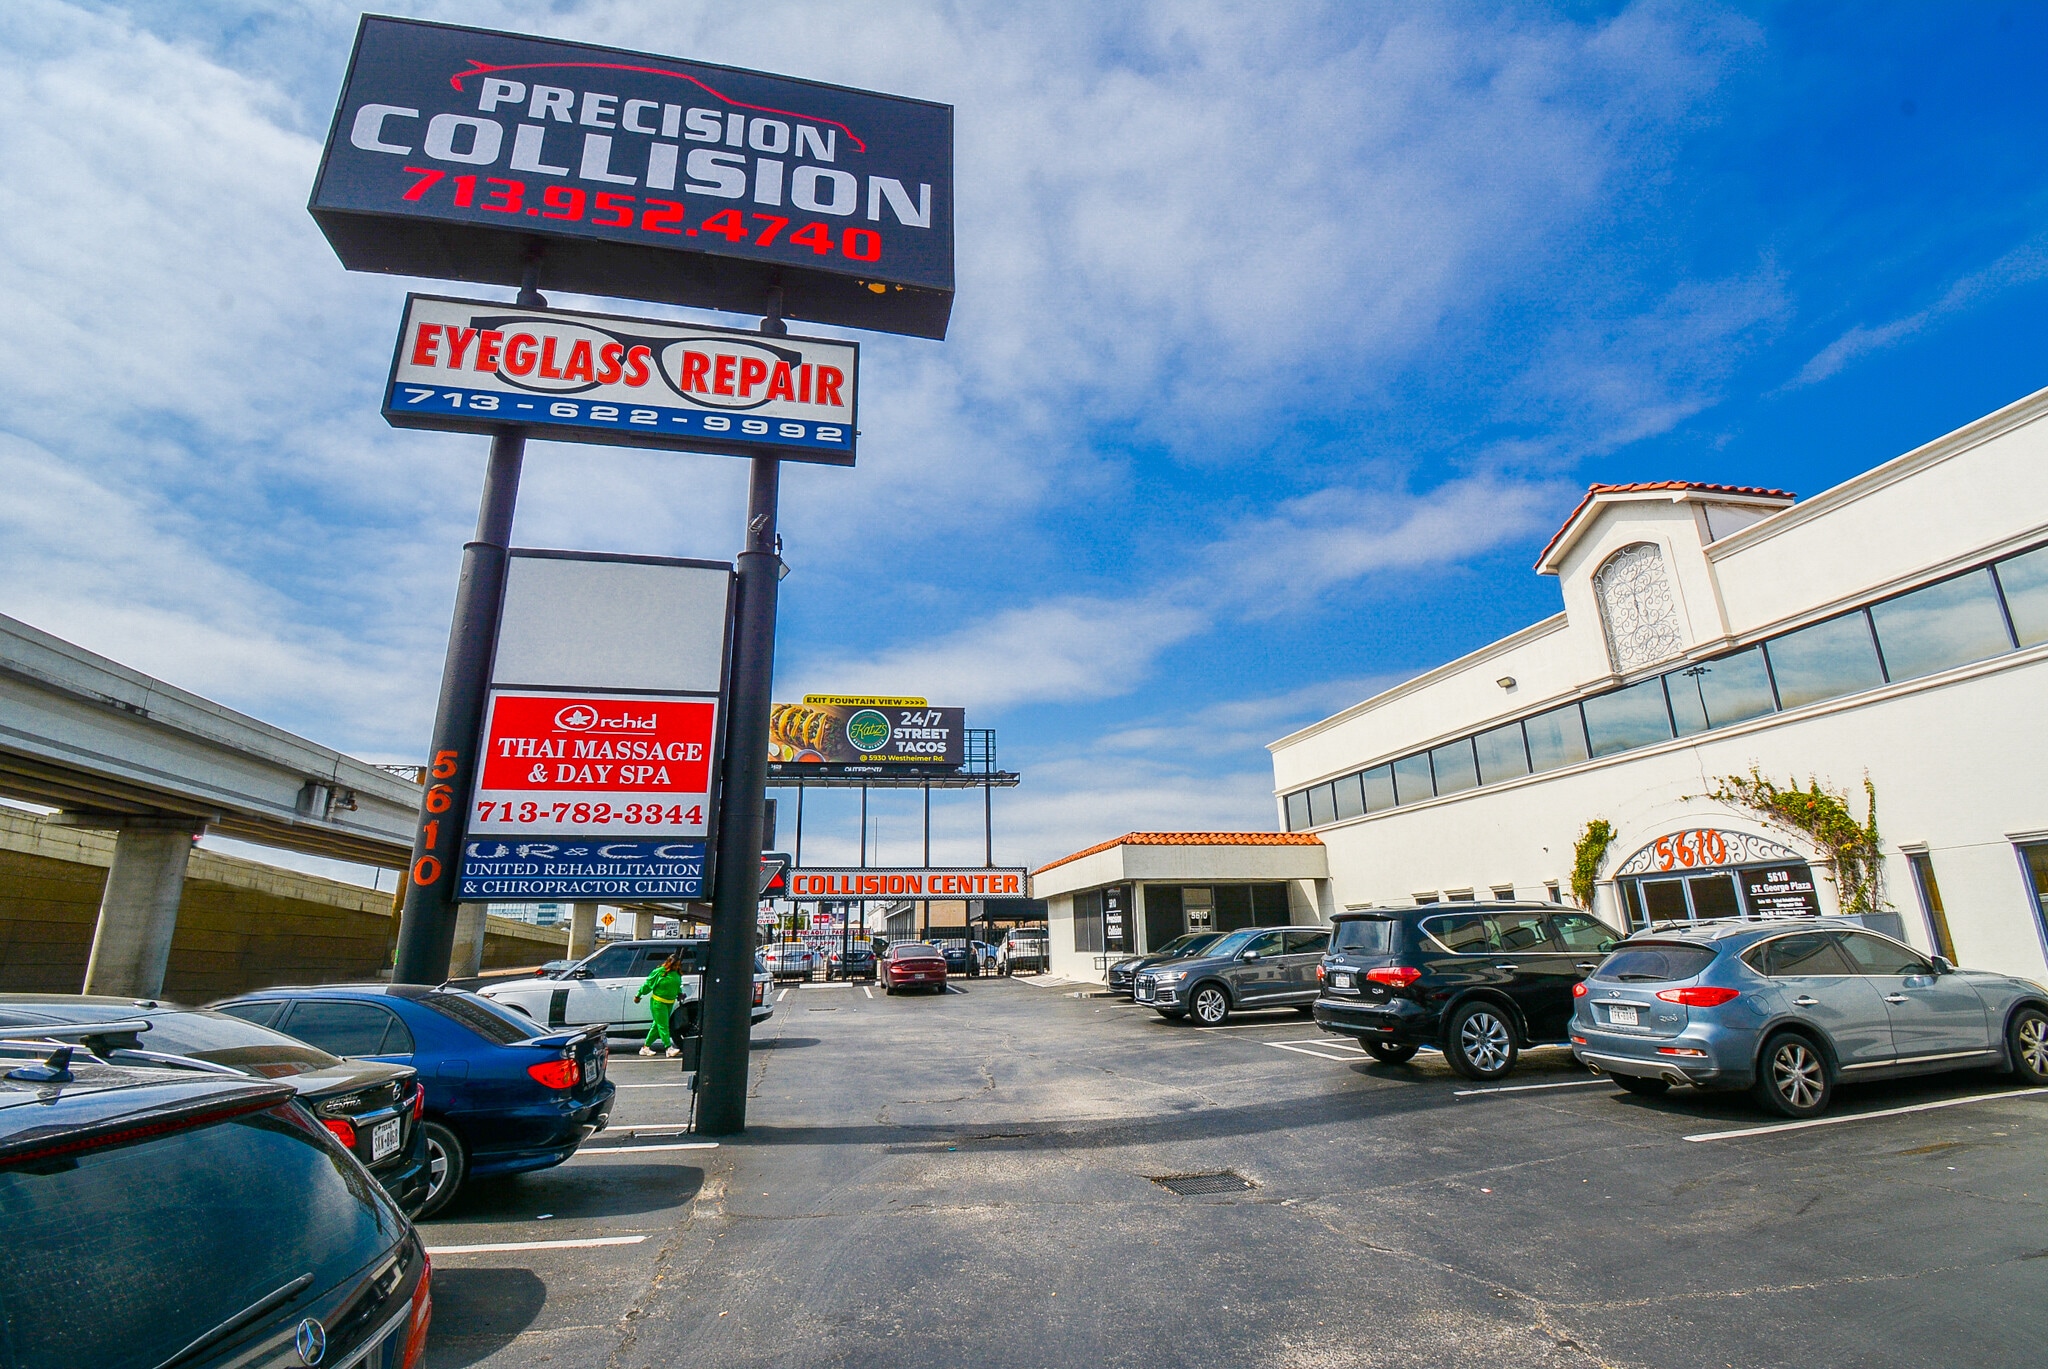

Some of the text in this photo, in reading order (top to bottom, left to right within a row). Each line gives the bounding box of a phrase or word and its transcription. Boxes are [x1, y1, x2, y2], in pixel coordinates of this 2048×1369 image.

[478, 77, 836, 163] PRECISION
[350, 103, 932, 229] COLLISION
[401, 166, 882, 263] 713.952.4740
[411, 322, 846, 409] EYEGLASS REPAIR
[829, 697, 876, 705] FOUNTAIN
[879, 698, 902, 706] VIEW
[900, 710, 942, 727] 24/7
[893, 728, 949, 739] STREET
[497, 737, 703, 761] THAI MASSAGE
[895, 741, 947, 753] TACOS
[859, 754, 868, 763] @
[887, 754, 932, 762] Westheimer
[527, 763, 672, 785] & DAY SPA
[476, 801, 703, 825] 713-782-3344
[1656, 828, 1726, 872] 5610
[464, 863, 701, 877] UNITED REHABILITATION
[1767, 871, 1789, 882] 5610
[463, 880, 698, 893] & CHIROPRACTOR CLINIC
[792, 874, 1019, 895] COLLISION CENTER
[1751, 881, 1812, 893] ST. George Plaza
[1191, 911, 1208, 919] 5610
